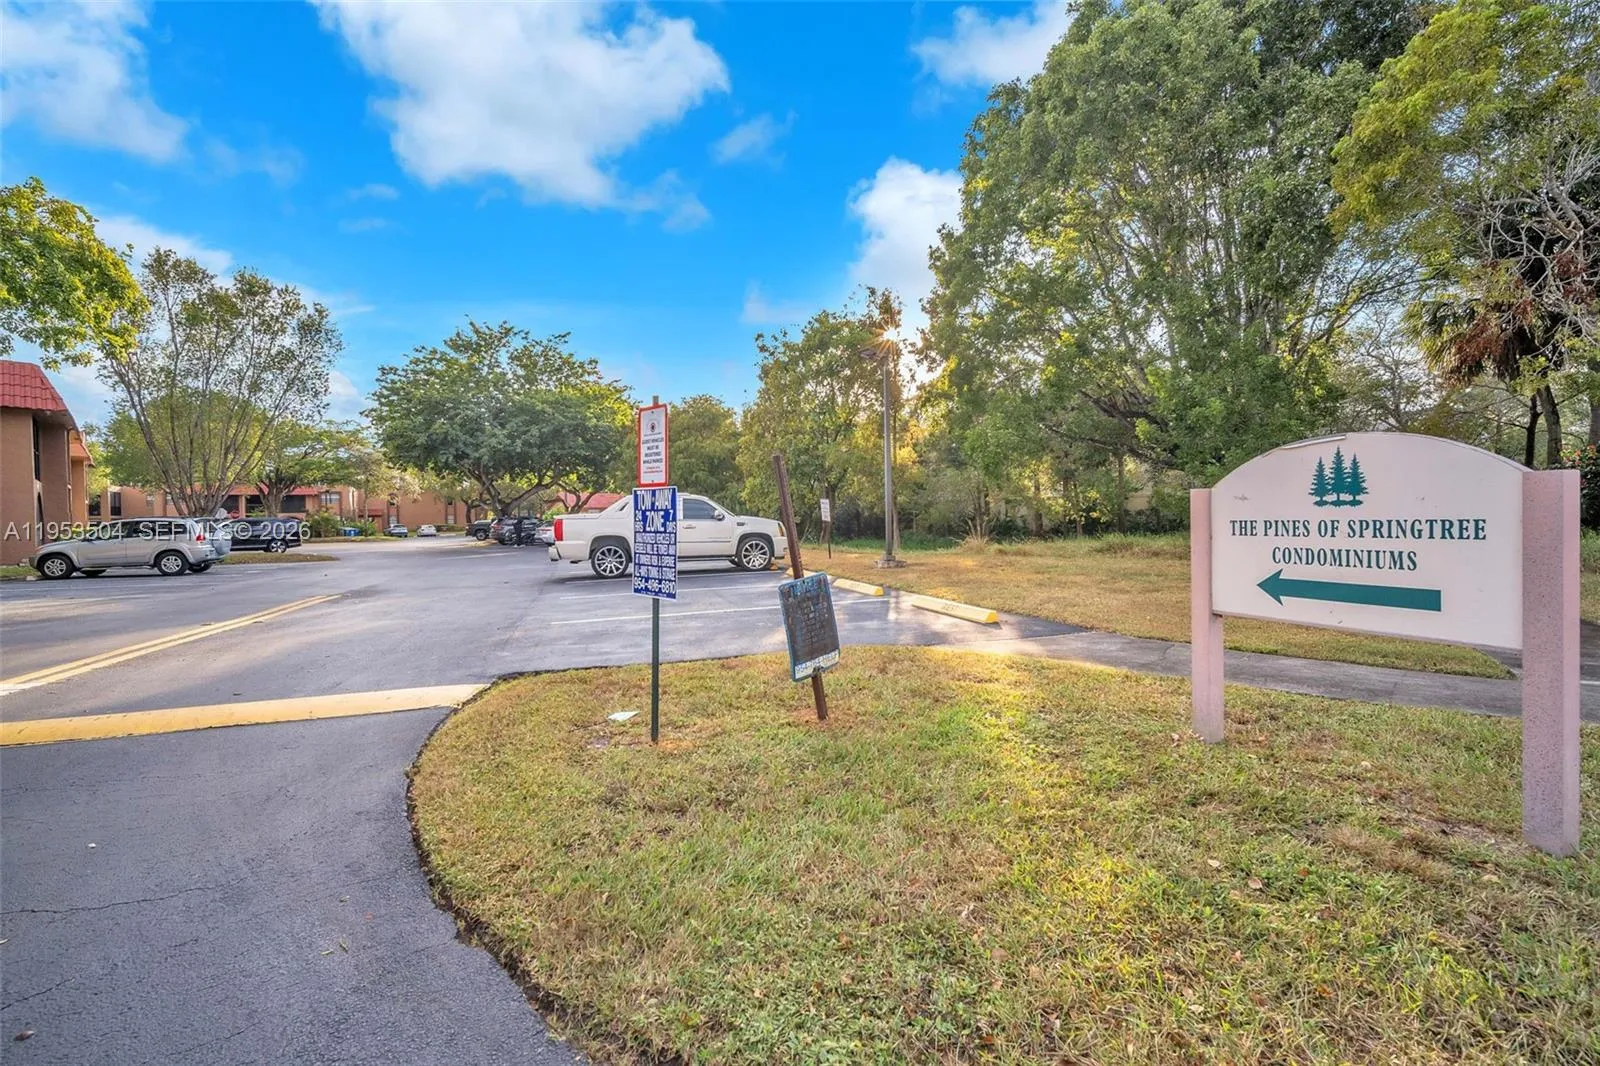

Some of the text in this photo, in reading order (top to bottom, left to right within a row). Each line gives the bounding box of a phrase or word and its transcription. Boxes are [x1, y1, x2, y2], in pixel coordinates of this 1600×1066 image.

[636, 510, 642, 520] 24
[646, 511, 664, 531] ZONE
[669, 510, 674, 520] 7
[666, 522, 676, 532] DAYS
[1230, 518, 1487, 540] THE PINES OF SPRINGTREE
[1272, 546, 1418, 571] CONDOMINIUMS
